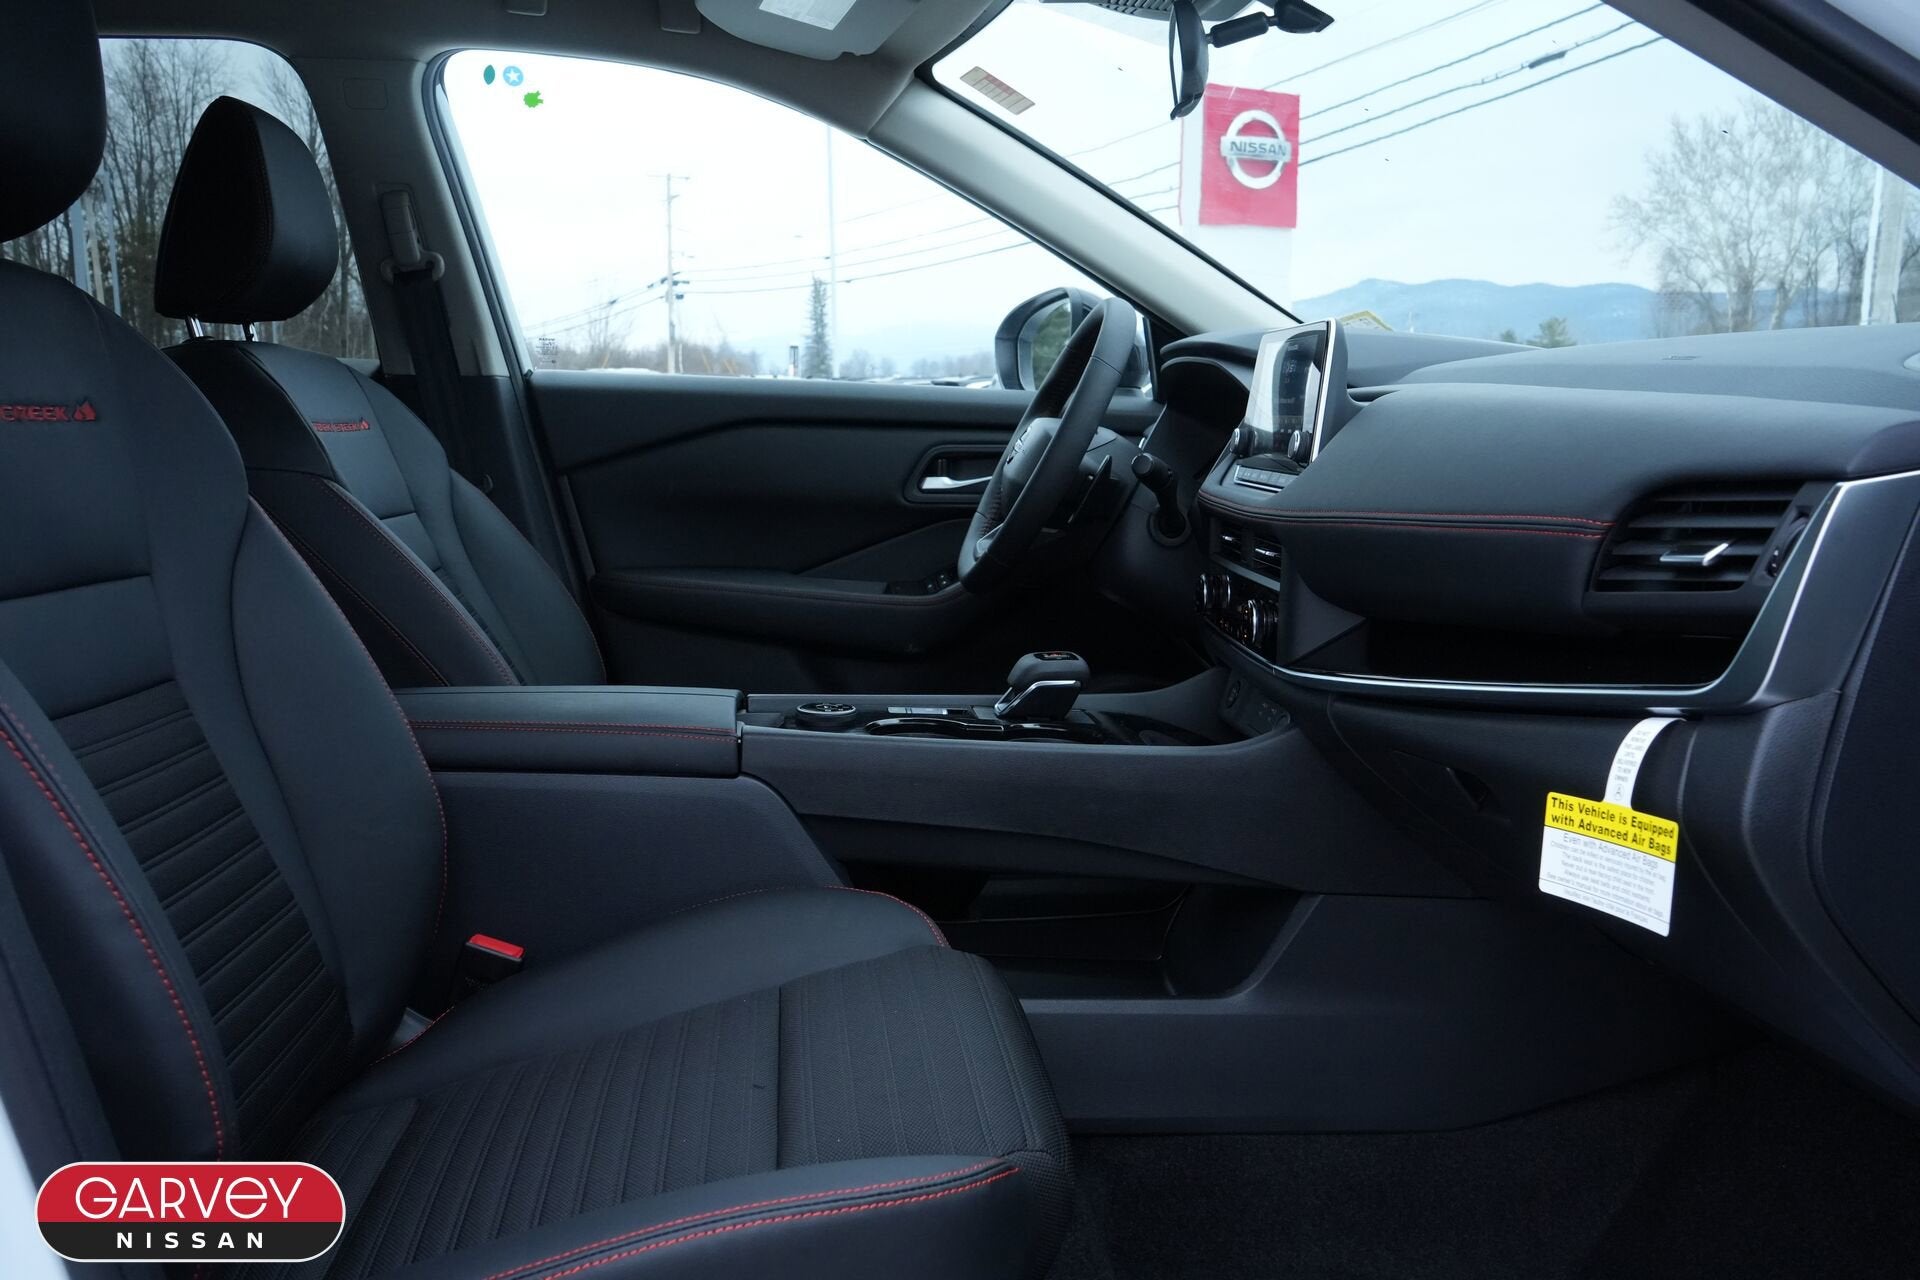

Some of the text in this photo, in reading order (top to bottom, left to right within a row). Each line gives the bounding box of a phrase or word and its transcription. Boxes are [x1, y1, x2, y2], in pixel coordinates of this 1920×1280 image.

[1230, 141, 1286, 156] NISSAN
[1551, 797, 1675, 839] This Vehicle is Equipped
[1551, 814, 1672, 856] with Advanced Air Bags
[1599, 843, 1631, 860] Advanced
